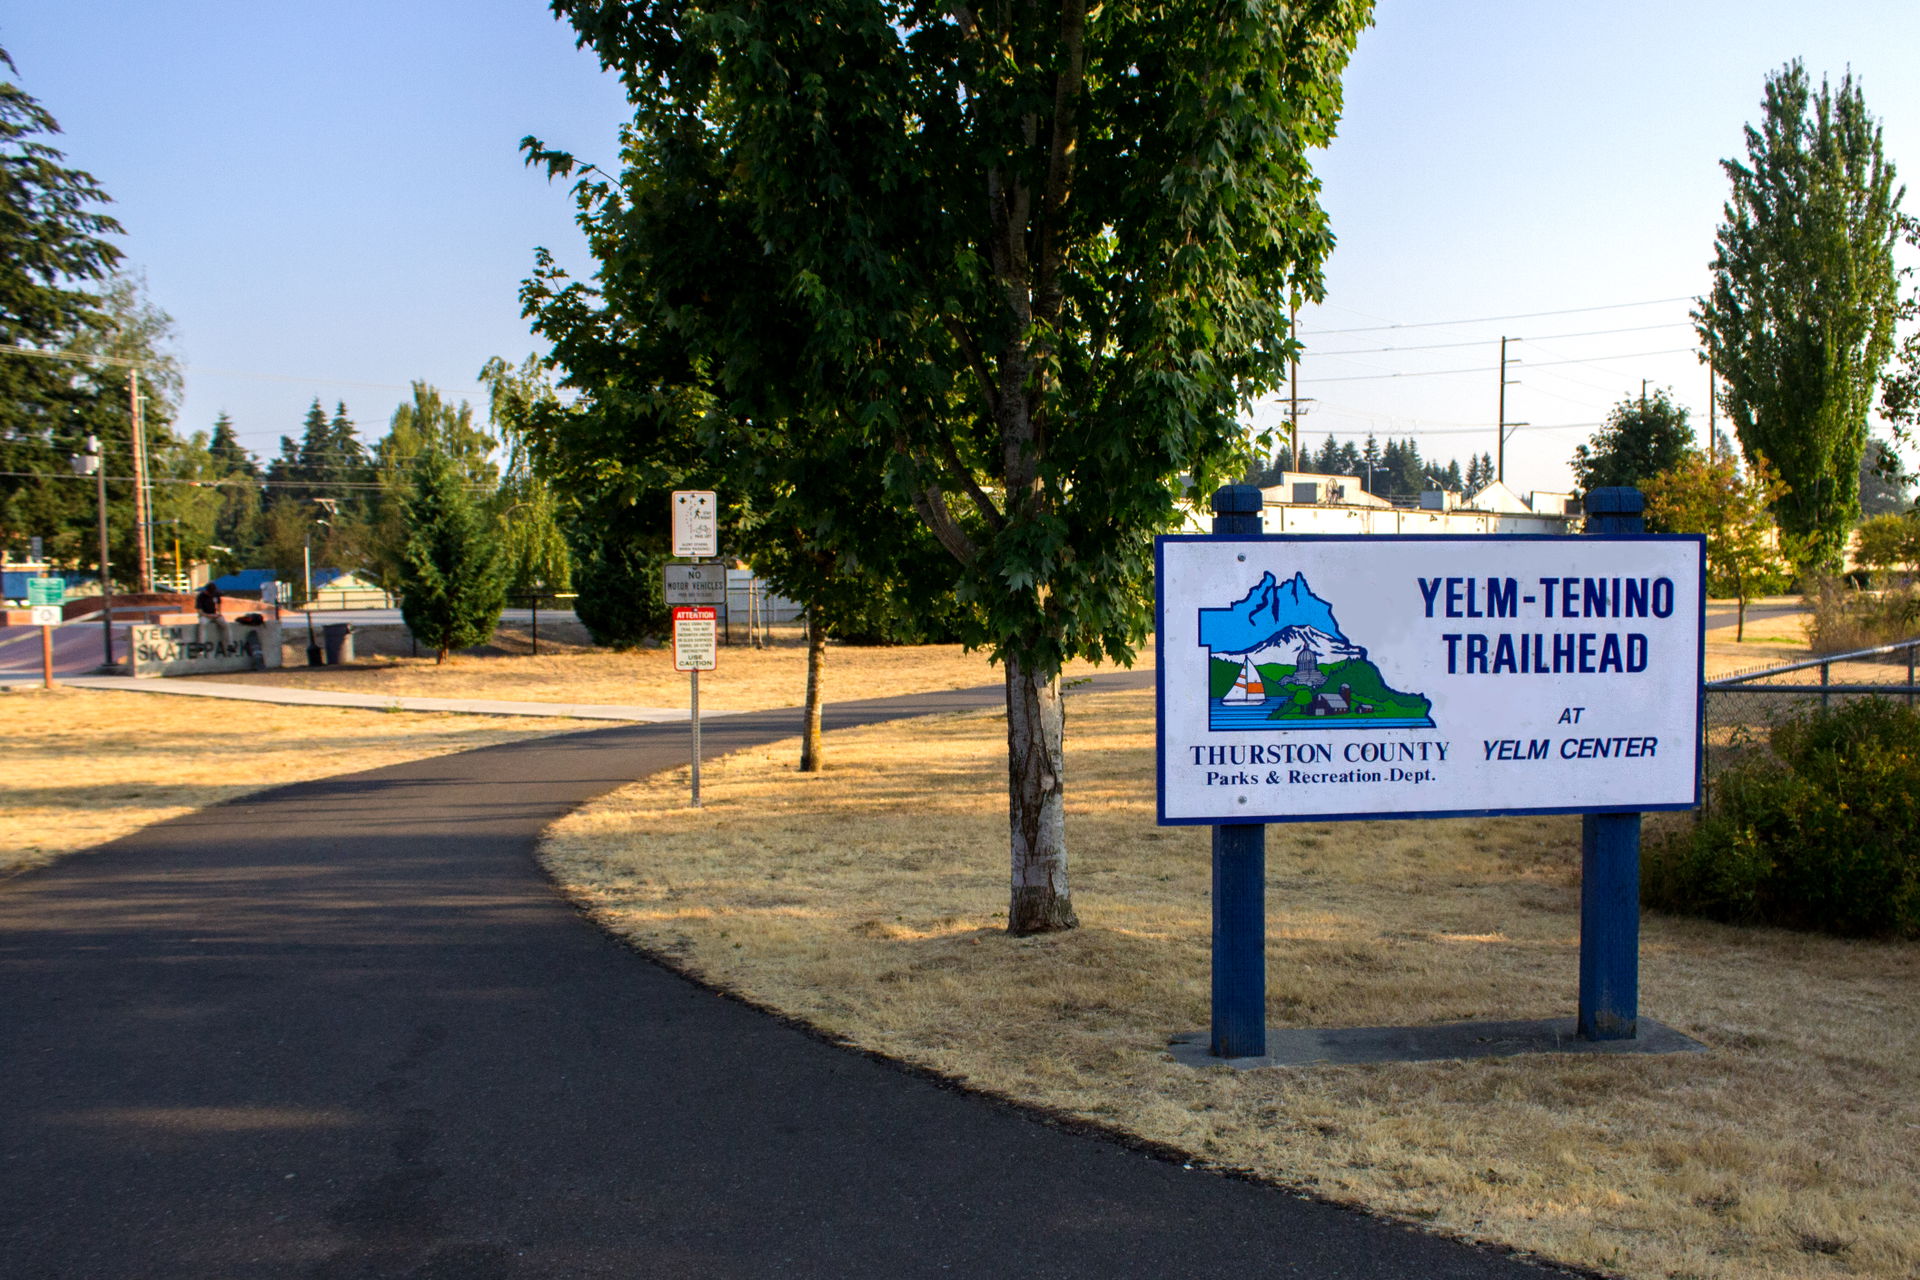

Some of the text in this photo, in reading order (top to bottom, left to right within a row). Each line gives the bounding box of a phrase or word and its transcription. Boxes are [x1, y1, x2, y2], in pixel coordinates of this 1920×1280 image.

[688, 571, 701, 579] NO
[667, 581, 723, 590] MOTOR VEHICLES
[1417, 576, 1675, 619] YELM-TENINO
[676, 611, 714, 619] ATTENTION
[136, 628, 182, 641] YELM
[1441, 632, 1649, 675] TRAILHEAD
[1558, 707, 1586, 725] AT
[1189, 741, 1451, 766] THURSTON COUNTY
[1483, 736, 1659, 760] YELM CENTER
[1206, 768, 1437, 786] Parks & Recreation Dept.
